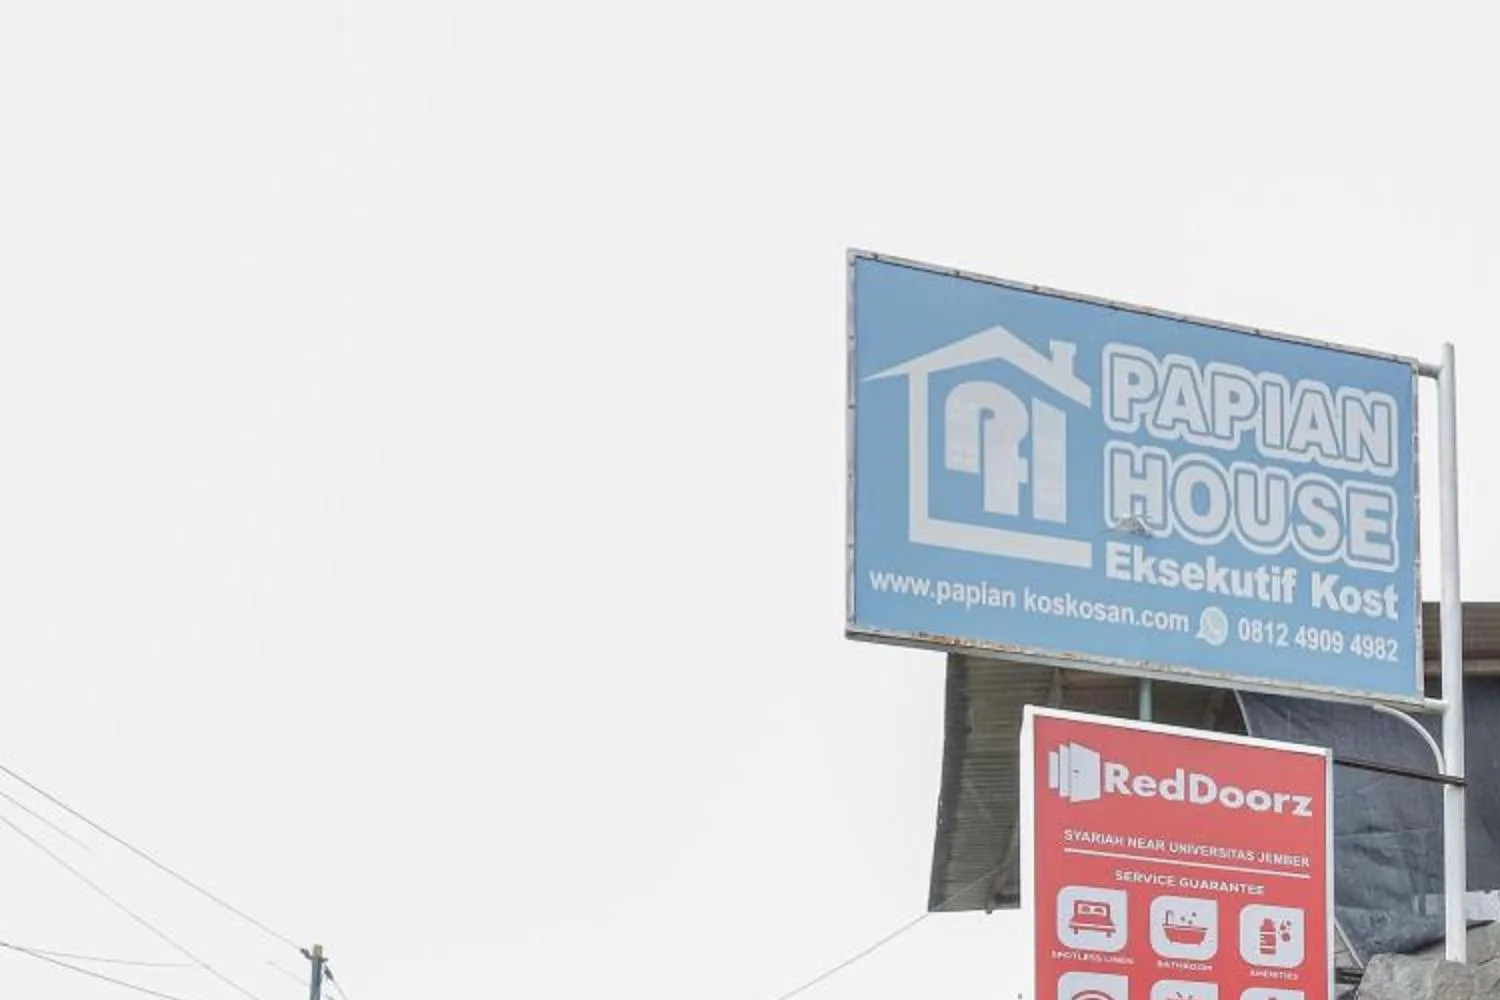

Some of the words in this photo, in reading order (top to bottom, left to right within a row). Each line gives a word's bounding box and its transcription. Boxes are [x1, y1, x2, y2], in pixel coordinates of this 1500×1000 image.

[1105, 345, 1396, 474] PAPIAN
[1105, 444, 1397, 571] HOUSE
[1105, 540, 1297, 604] Eksekutif
[1311, 570, 1399, 620] Kost
[1024, 586, 1189, 633] koskosan.com
[1238, 617, 1290, 647] 0812
[1295, 625, 1344, 654] 4909
[1350, 633, 1399, 662] 4982
[1103, 761, 1314, 817] RedDoorz
[1063, 829, 1124, 846] SYARIAH
[1128, 837, 1165, 851] NEAR
[1169, 842, 1255, 861] UNIVERSITAS
[1257, 853, 1310, 867] JEMBER
[1115, 869, 1177, 886] SERVICE
[1179, 876, 1265, 895] GUARANTEE
